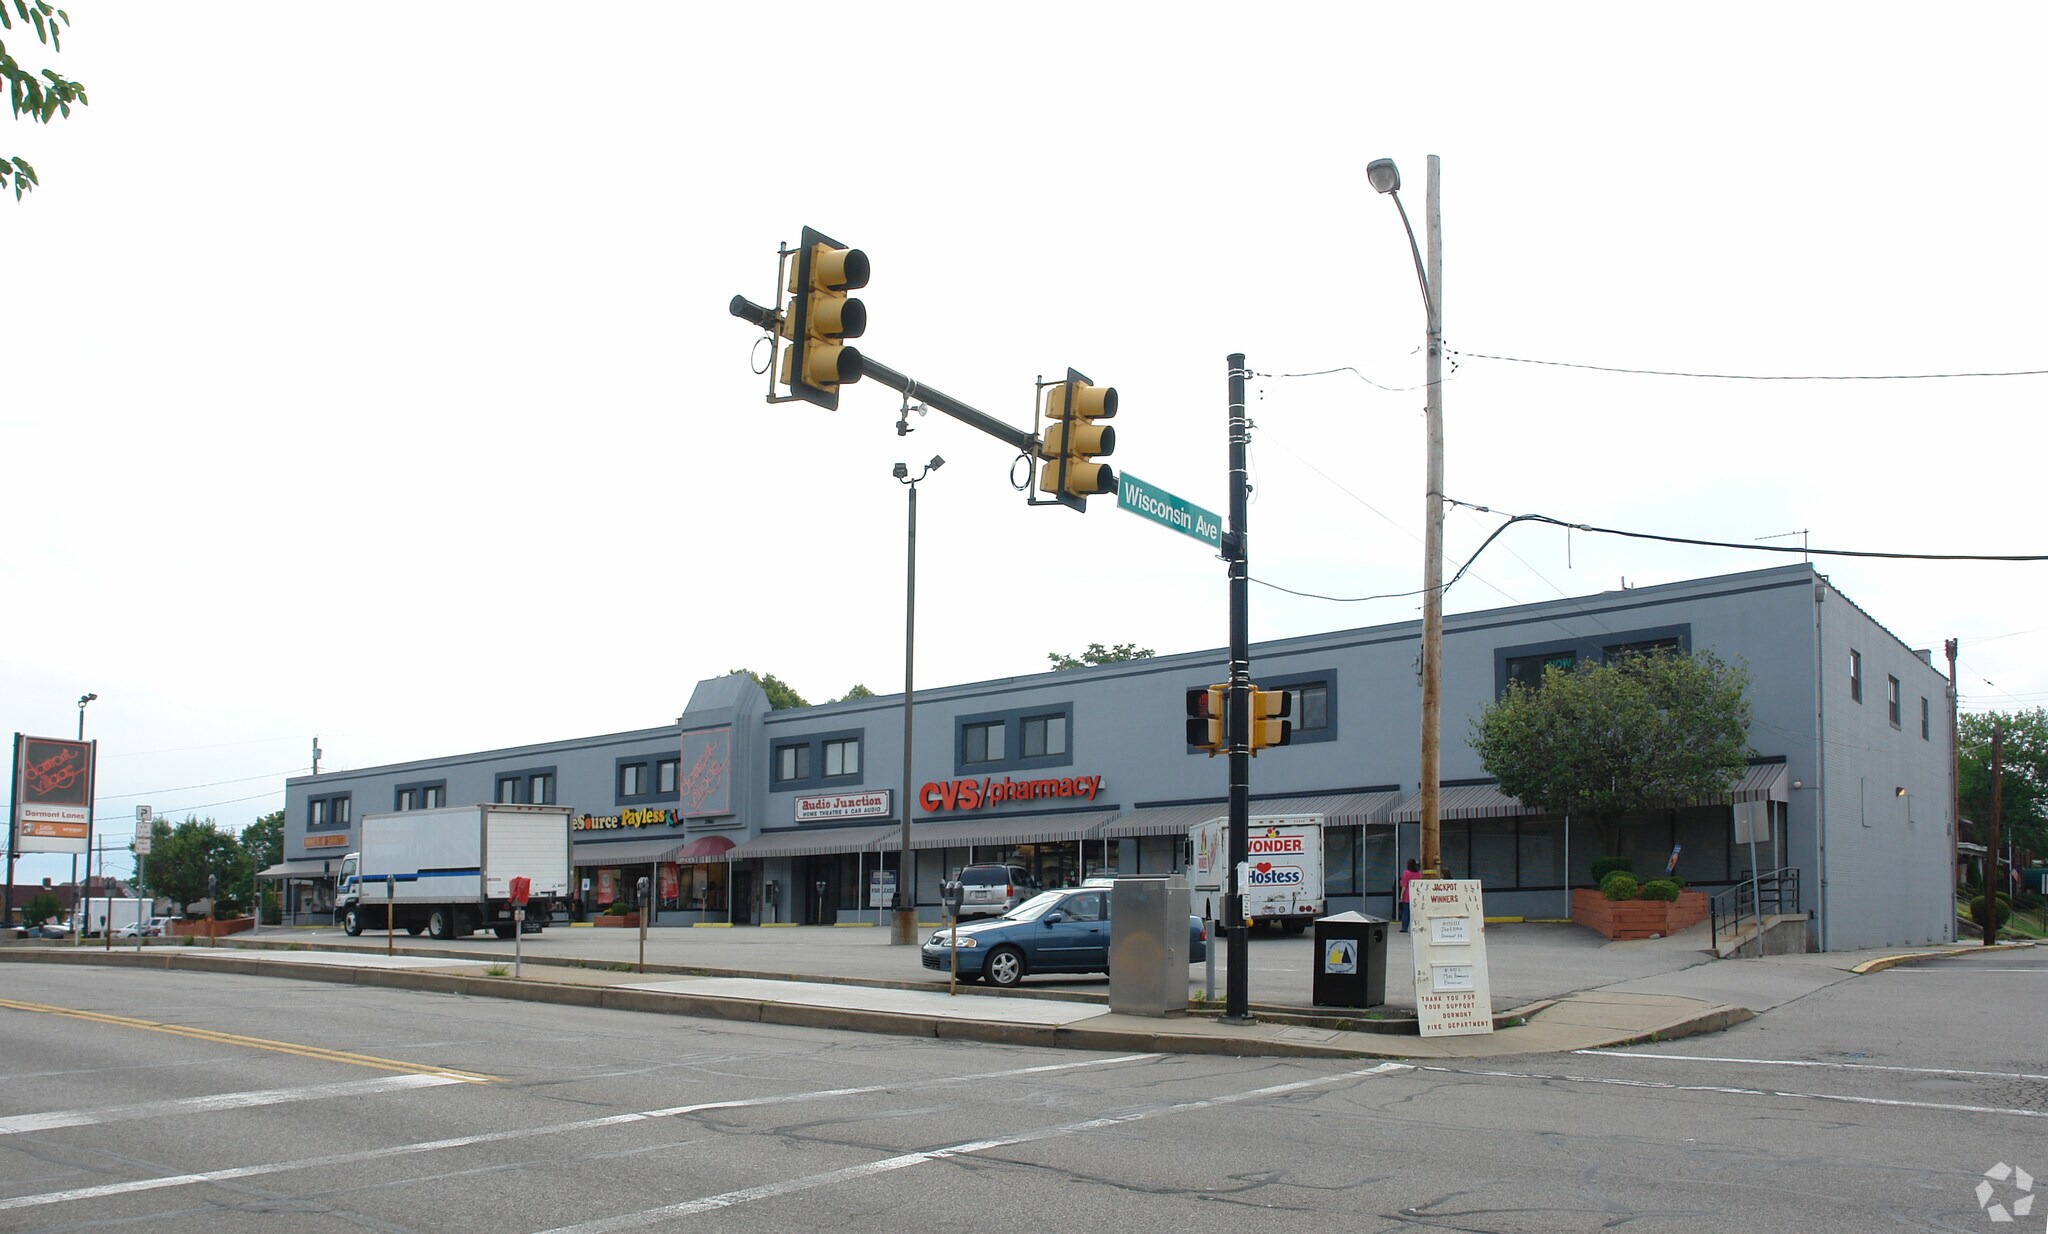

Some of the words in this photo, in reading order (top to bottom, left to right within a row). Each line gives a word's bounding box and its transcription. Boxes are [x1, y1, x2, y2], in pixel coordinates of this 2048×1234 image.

[1125, 482, 1191, 529] Wisconsin
[1196, 515, 1217, 540] Ave
[919, 776, 1101, 812] CVS/pharmacy
[834, 796, 882, 808] Junction
[25, 810, 59, 818] Dormont
[62, 811, 85, 819] Lanes
[621, 808, 665, 828] Payless
[1249, 870, 1300, 883] Hostess
[1432, 883, 1457, 891] JACKPOT
[1431, 895, 1458, 903] WINNERS
[1442, 1011, 1472, 1019] DORMONT
[1447, 1020, 1488, 1029] DEPARTMENT
